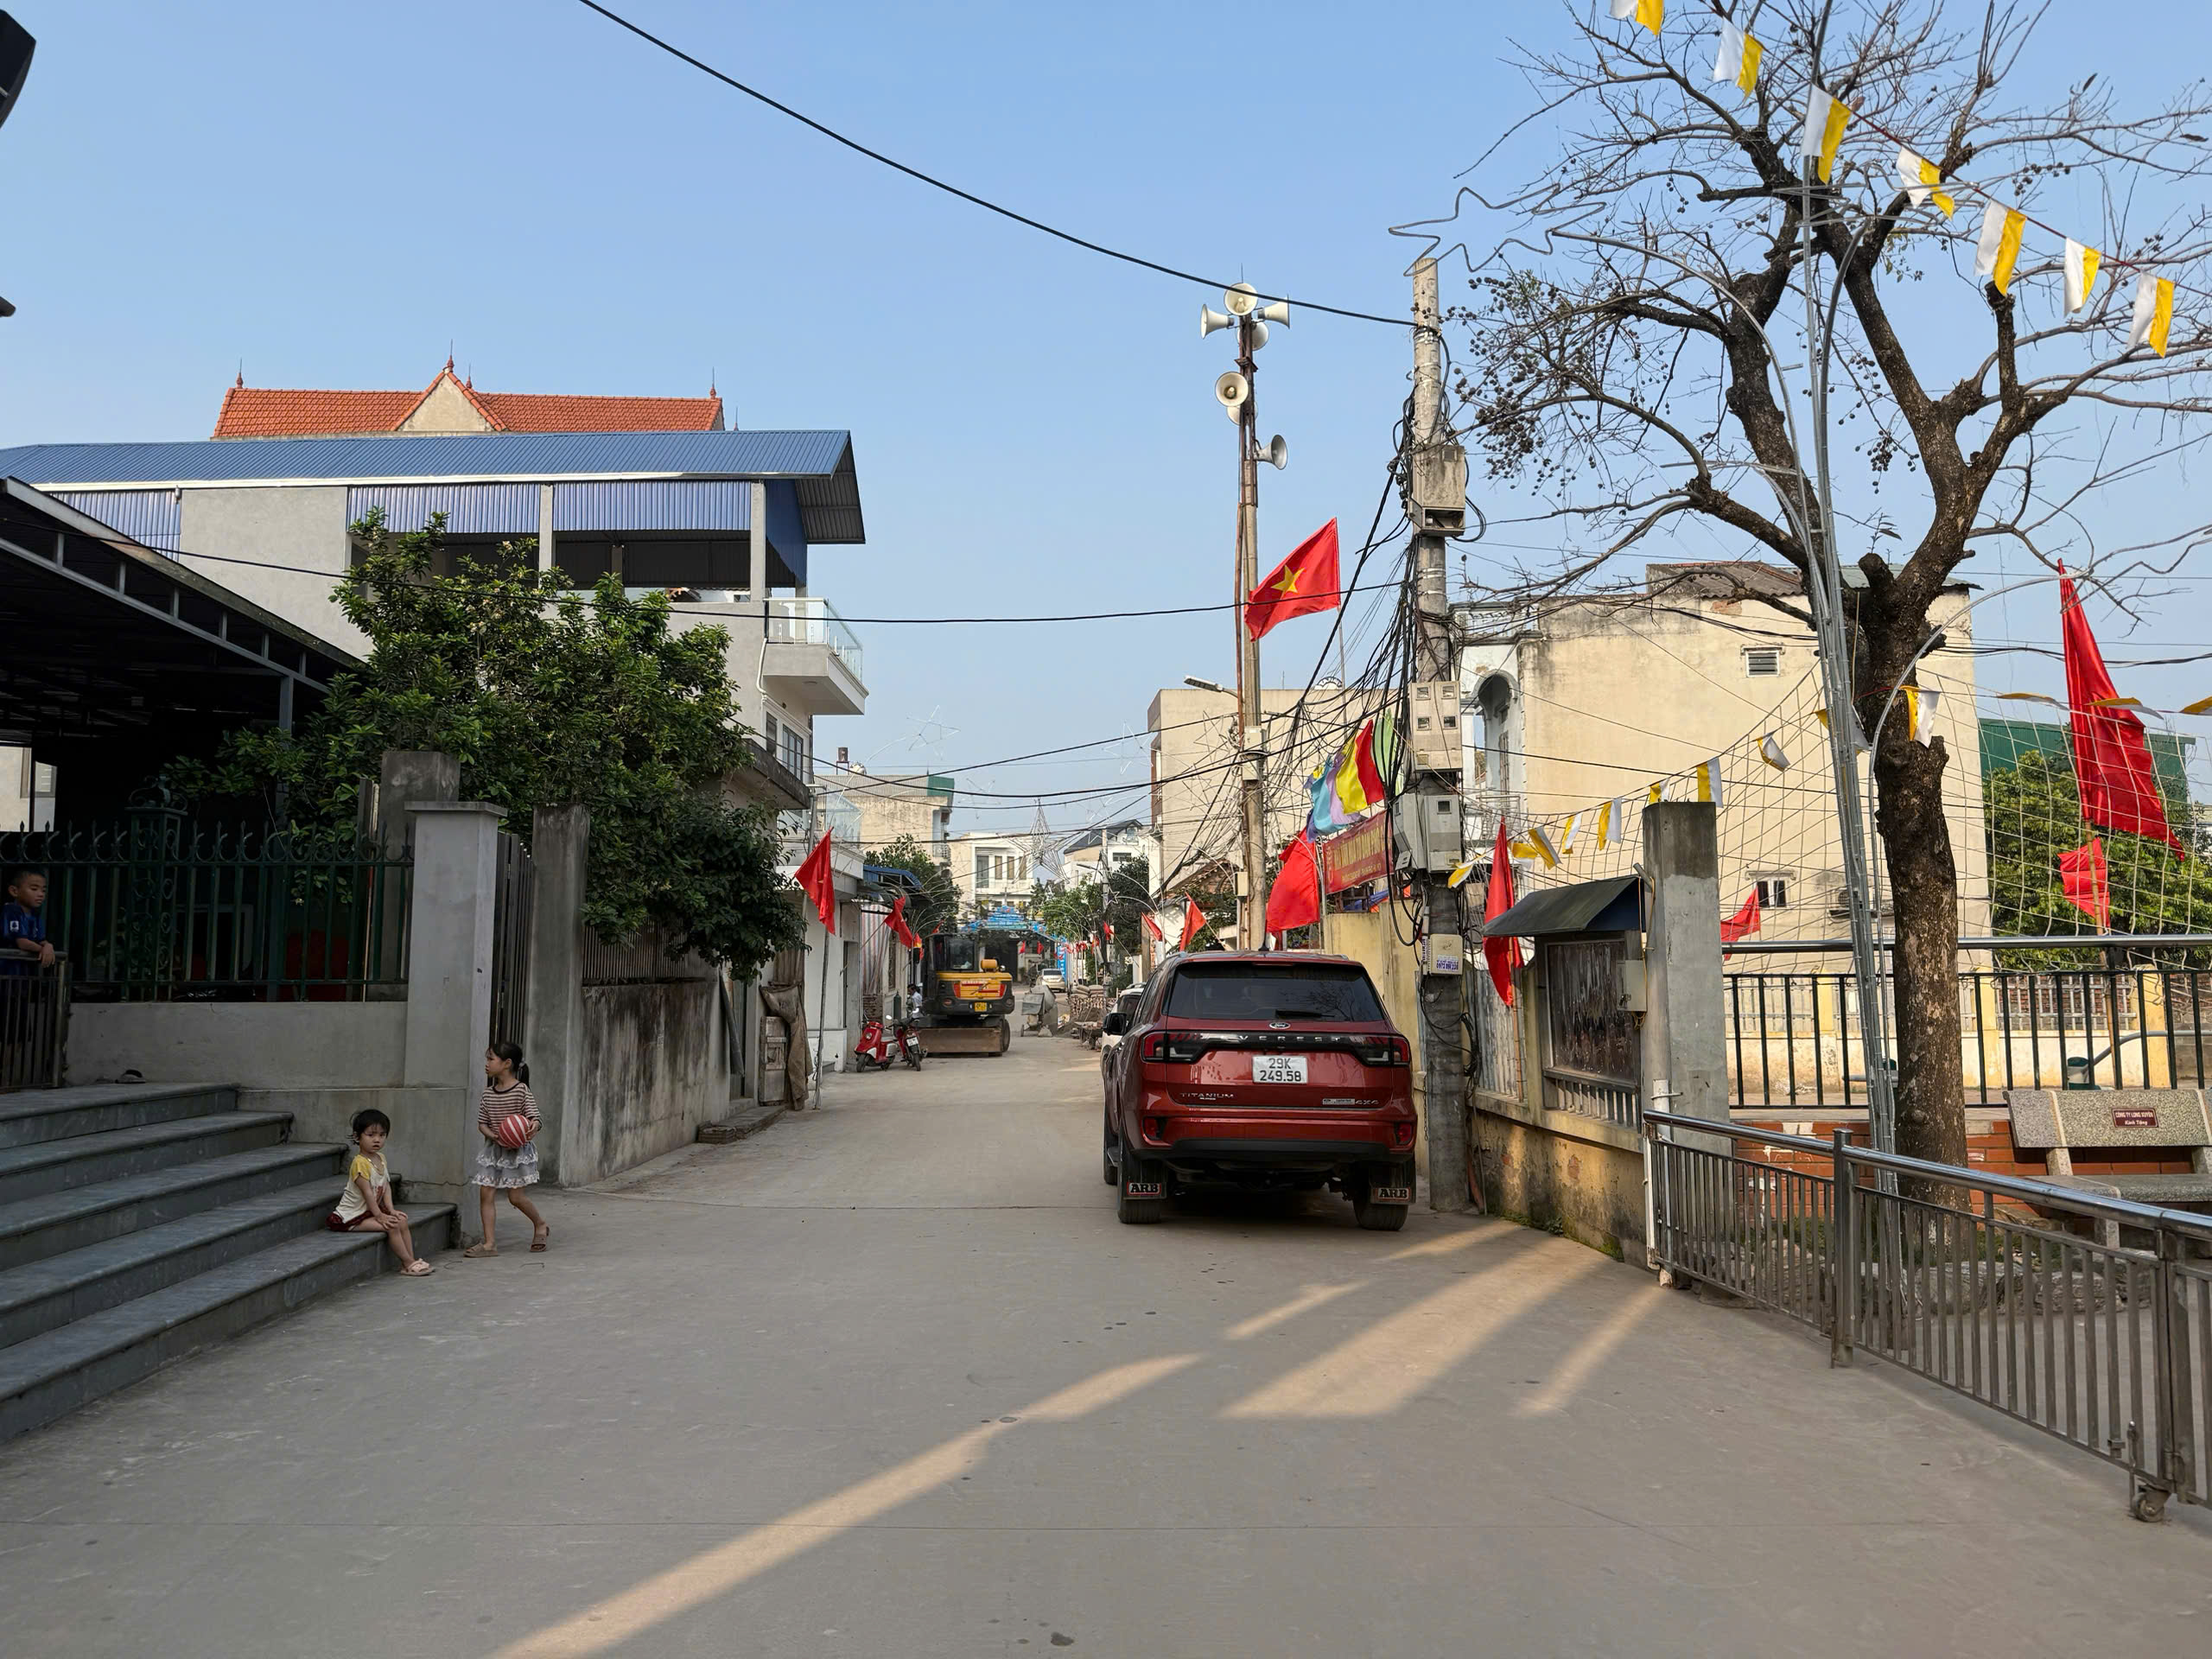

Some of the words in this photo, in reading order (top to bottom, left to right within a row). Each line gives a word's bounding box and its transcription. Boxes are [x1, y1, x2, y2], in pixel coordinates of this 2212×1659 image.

[1268, 1058, 1291, 1069] 29K
[1259, 1070, 1301, 1082] 249.58
[1130, 1184, 1159, 1193] ARB
[1379, 1188, 1408, 1198] ARB
